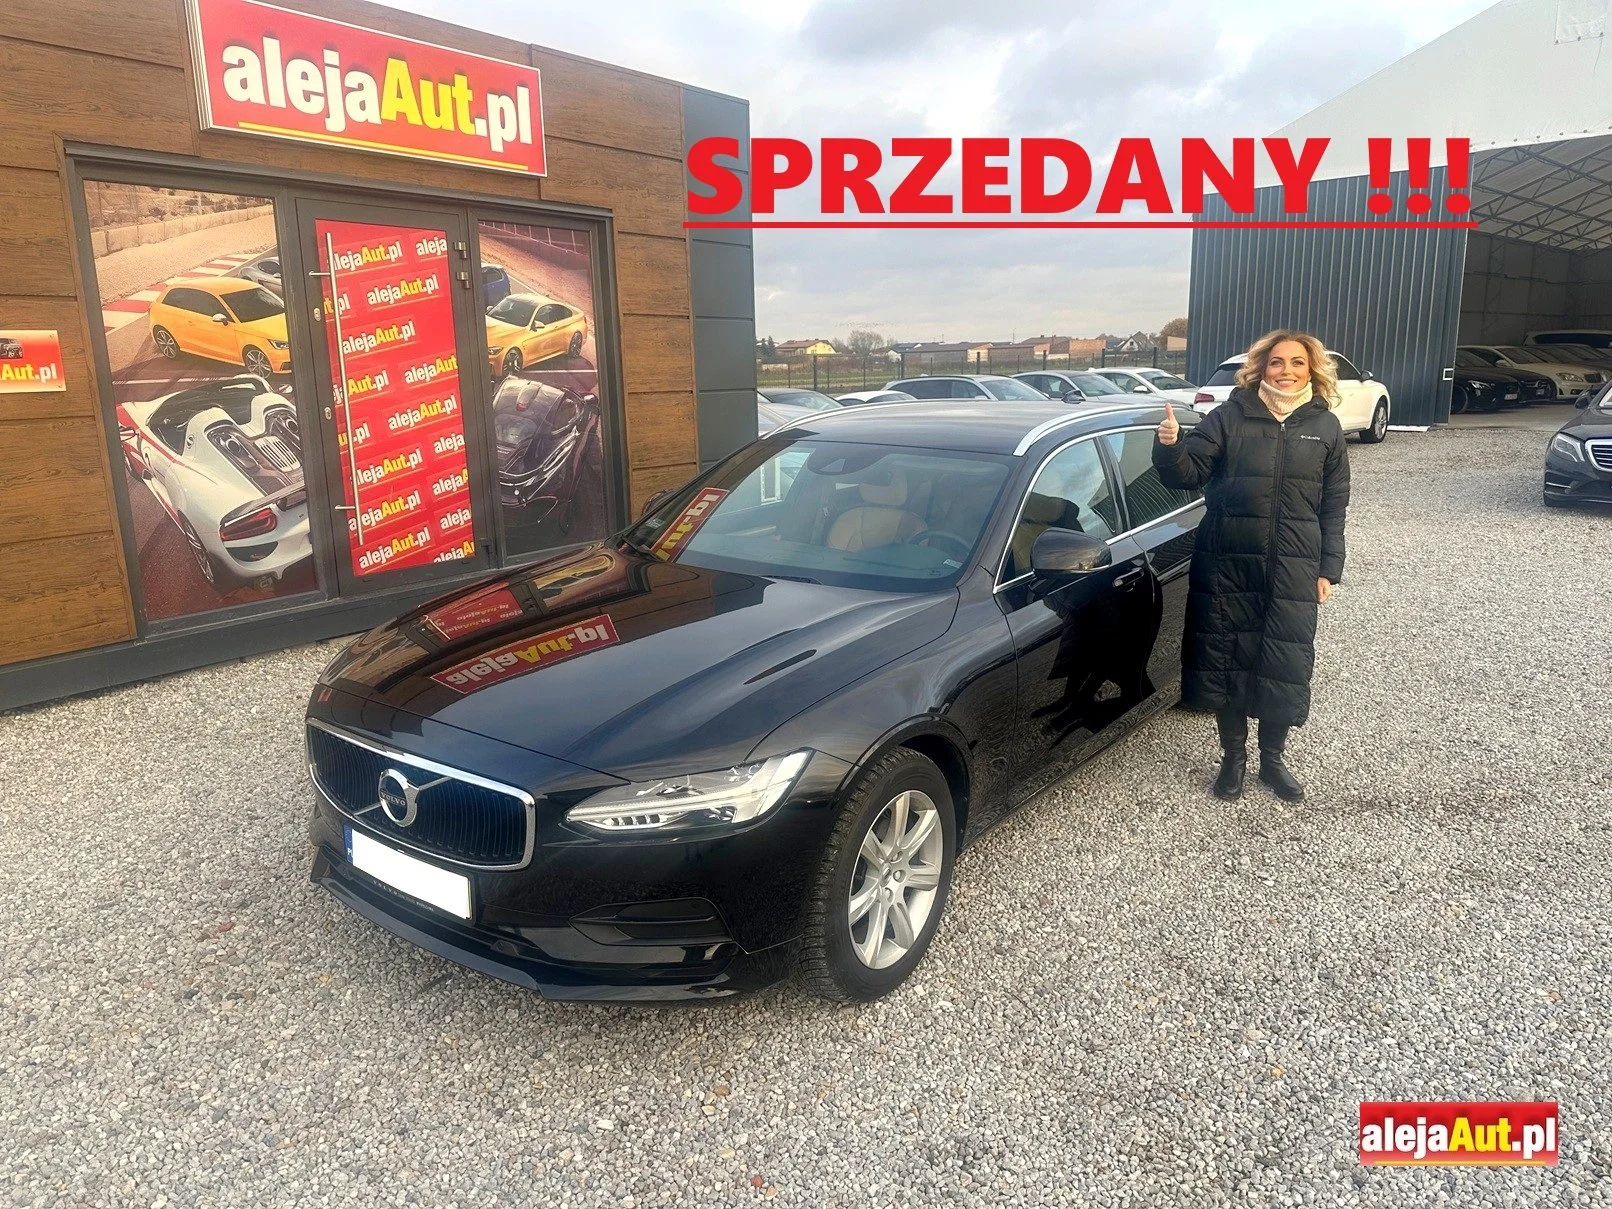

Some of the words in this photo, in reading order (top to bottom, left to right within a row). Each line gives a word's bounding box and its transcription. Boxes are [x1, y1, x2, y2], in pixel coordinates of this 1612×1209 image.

[222, 36, 533, 153] alejaAut.pl
[366, 274, 439, 305] alejaAut.pl
[342, 319, 416, 354] alejaAut.pl
[404, 355, 457, 384] alejaAut
[388, 395, 457, 430] alejaAut.pl
[433, 433, 465, 454] aleja
[347, 490, 421, 531] aejaAut.pl
[358, 527, 431, 568] alejaAut.pl
